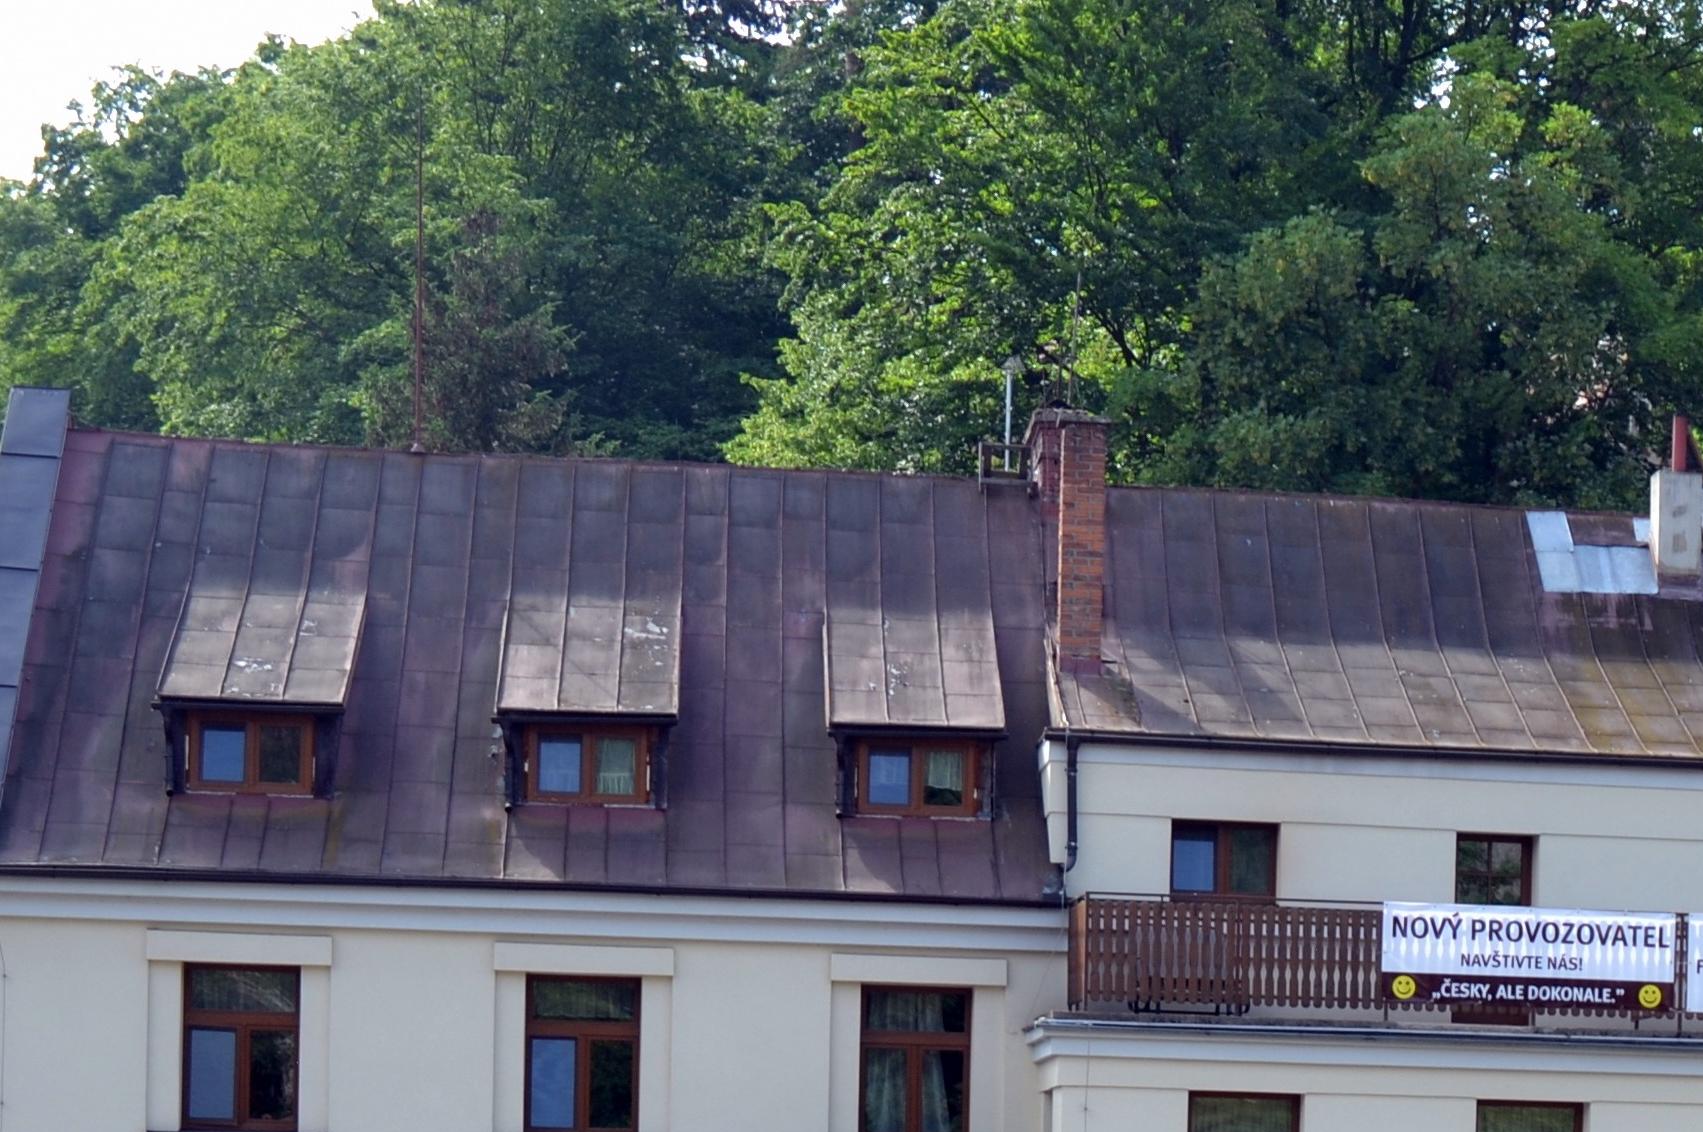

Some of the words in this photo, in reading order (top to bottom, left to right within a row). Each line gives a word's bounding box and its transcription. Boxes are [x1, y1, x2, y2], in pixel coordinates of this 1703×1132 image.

[1392, 912, 1462, 940] NOVÝ
[1471, 918, 1670, 948] PROVOZOVATEL
[1461, 950, 1543, 970] NAVŠTIVTE
[1547, 954, 1583, 971] NÁS!
[1496, 984, 1524, 1000] ALE
